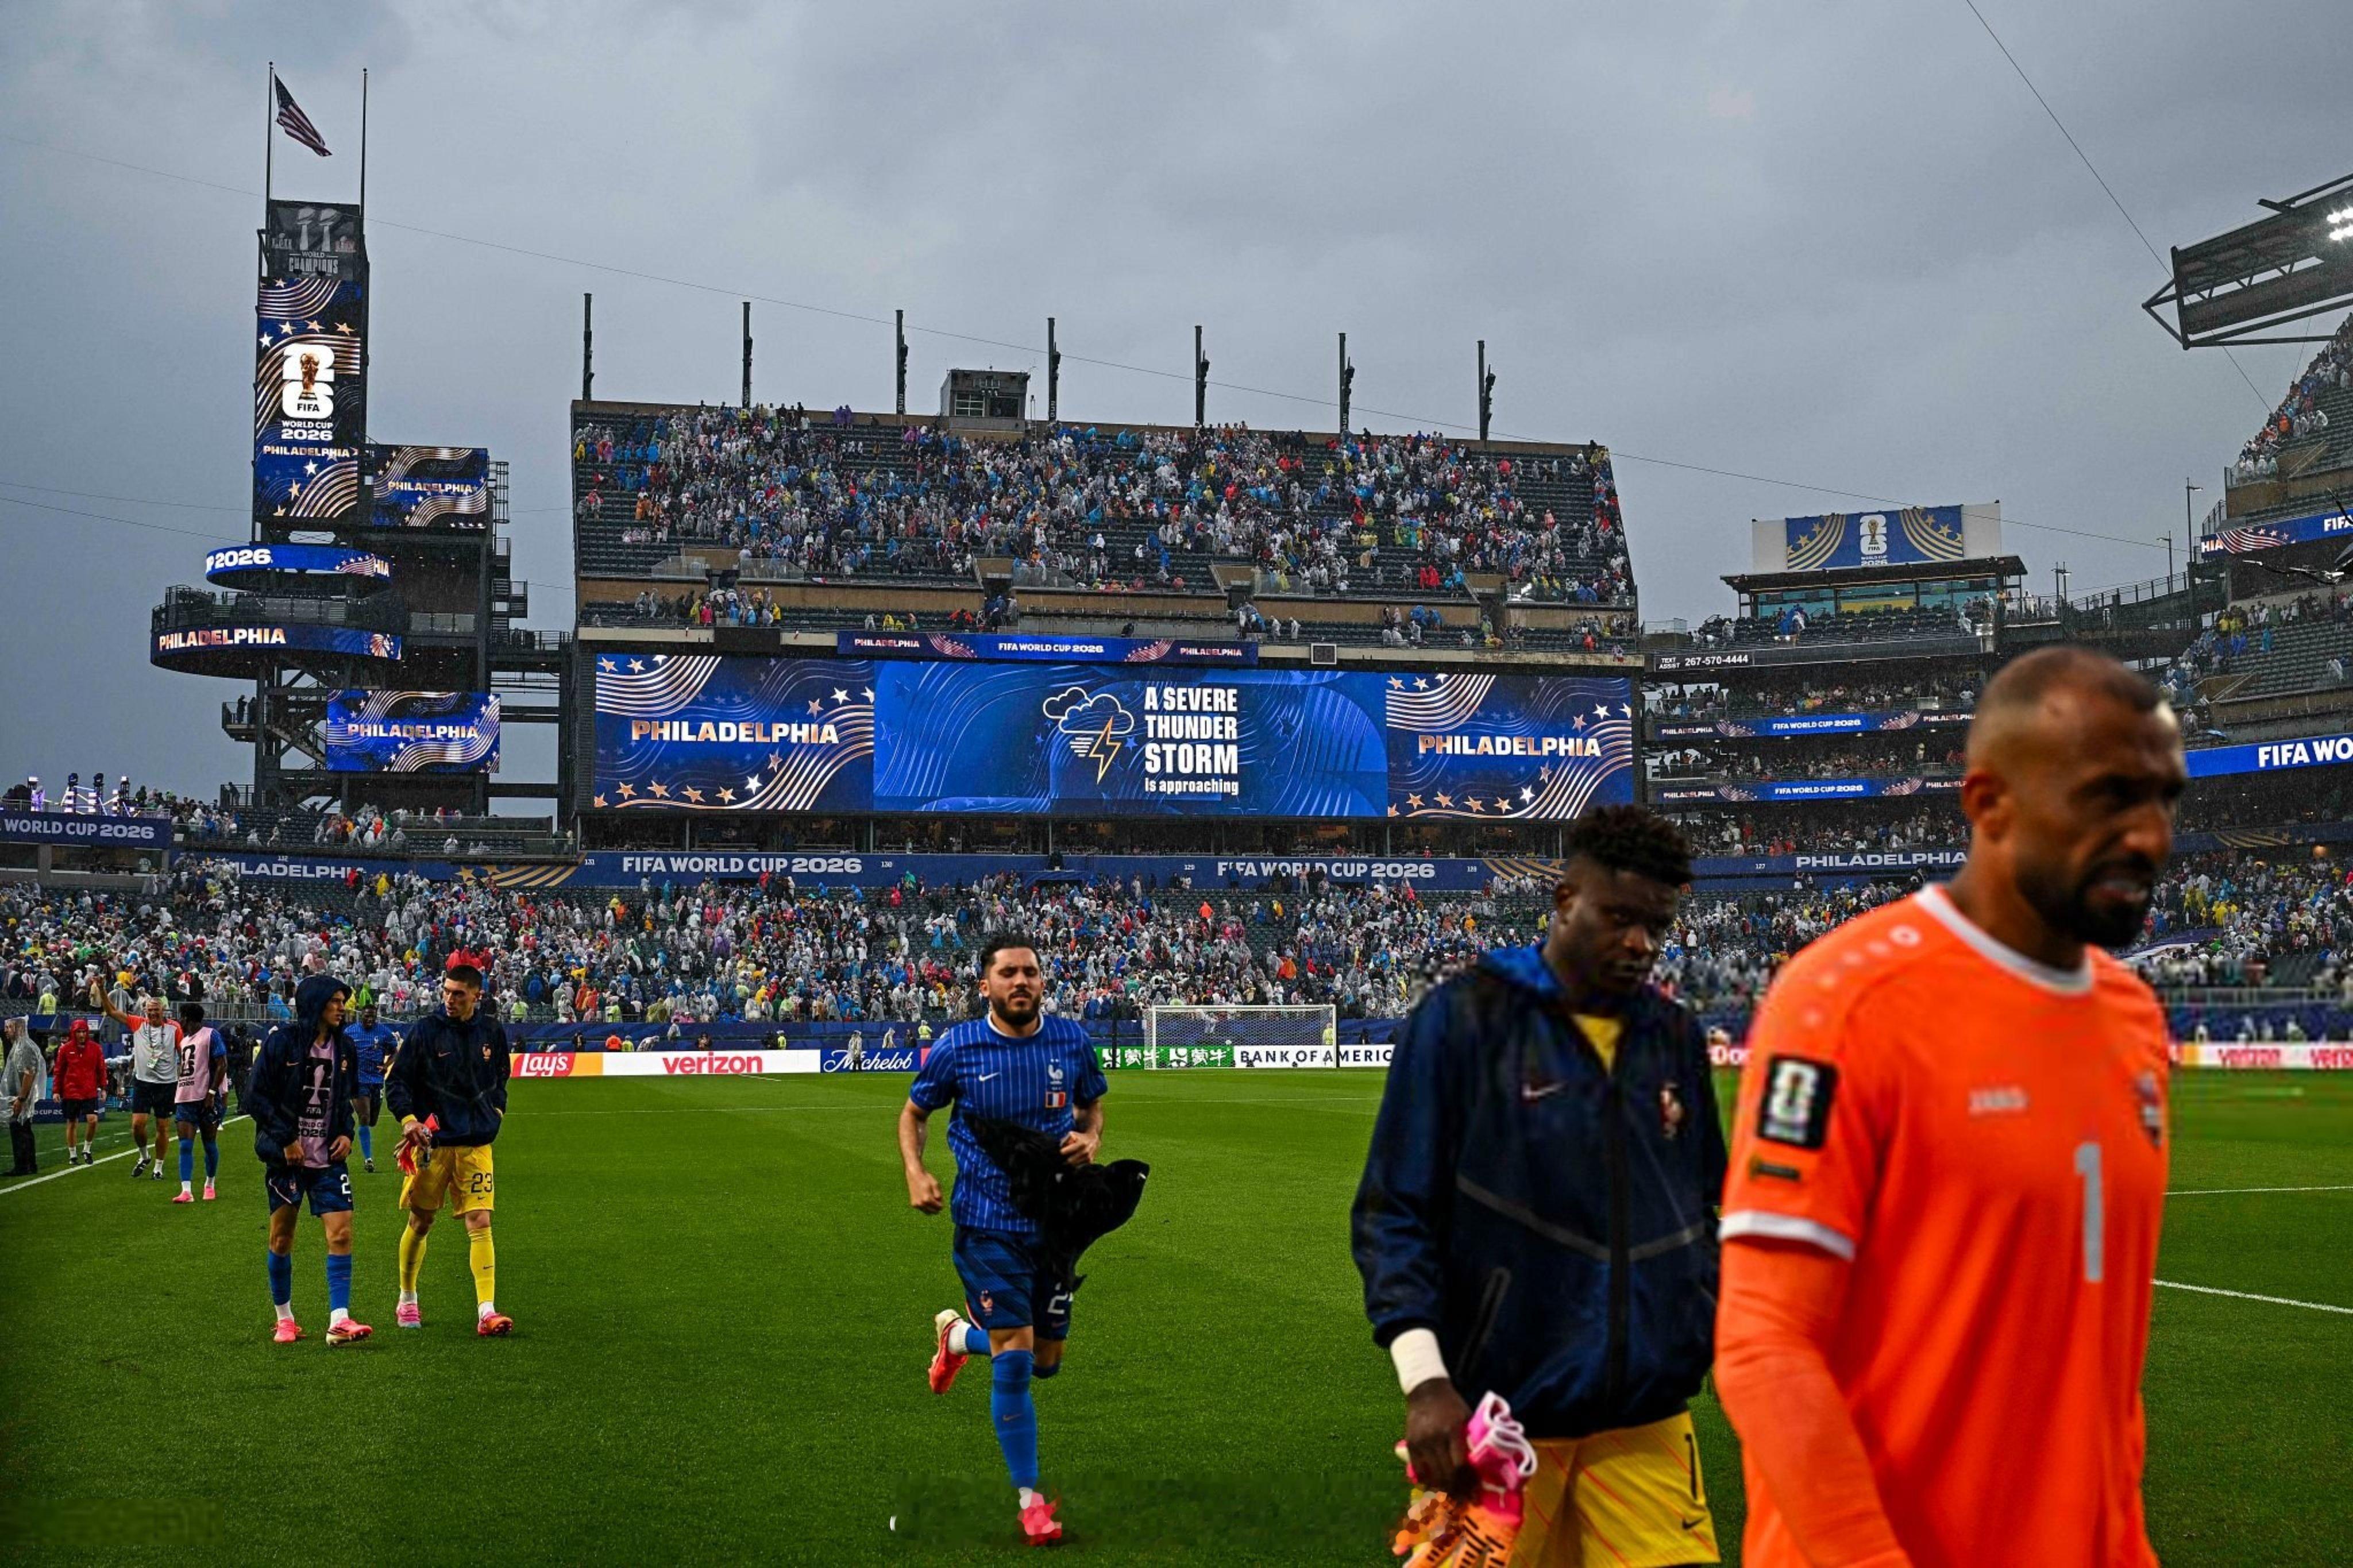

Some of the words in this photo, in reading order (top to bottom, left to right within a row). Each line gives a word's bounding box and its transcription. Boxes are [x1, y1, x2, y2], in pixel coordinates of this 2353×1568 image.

[297, 403, 320, 412] FIFA
[281, 420, 314, 428] WORLD
[315, 422, 334, 430] CUP
[281, 428, 333, 441] 2026
[263, 445, 350, 458] PHILADELPHIA
[388, 481, 473, 493] PHILADELPHIA
[214, 549, 271, 569] 2026
[159, 628, 287, 651] PHILADELPHIA
[854, 639, 920, 648] PHILADELPHIA
[998, 643, 1019, 651] FIFA
[1020, 643, 1052, 652] WORLD
[1053, 643, 1071, 652] CUP
[1072, 644, 1104, 653] 2026
[1179, 647, 1242, 656] PHILADELPHIA
[1684, 654, 1748, 666] 267-570-4444
[1144, 687, 1159, 710] A
[1163, 688, 1238, 712] SEVERE
[347, 723, 479, 739] PHILADELPHIA
[632, 720, 839, 744] PHILADELPHIA
[1145, 715, 1237, 740] THUNDER
[1662, 727, 1713, 735] PHILADELPHIA
[1790, 721, 1817, 729] WORLD
[1418, 735, 1602, 756] PHILADELPHIA
[1145, 743, 1238, 774] STORM
[2258, 743, 2310, 768] FIFA
[1145, 778, 1156, 792] is
[1159, 778, 1239, 795] approaching
[1926, 780, 1968, 788] PHILADELP
[1663, 791, 1715, 799] PHILADELPHIA
[4, 818, 63, 833] WORLD
[65, 822, 97, 836] CUP
[99, 824, 155, 840] 2026
[623, 856, 667, 872] FIFA
[669, 857, 744, 872] WORLD
[747, 858, 788, 872] CUP
[792, 858, 862, 873] 2026
[1796, 852, 1968, 868] PHILADELPHIA
[1331, 862, 1368, 877] CUP
[1371, 863, 1436, 878] 2026
[520, 1053, 566, 1076] Lay's
[663, 1052, 763, 1074] verizon
[1240, 1050, 1289, 1063] BANK
[1295, 1050, 1318, 1063] OF
[470, 1172, 492, 1194] 23
[2074, 1141, 2104, 1284] 1
